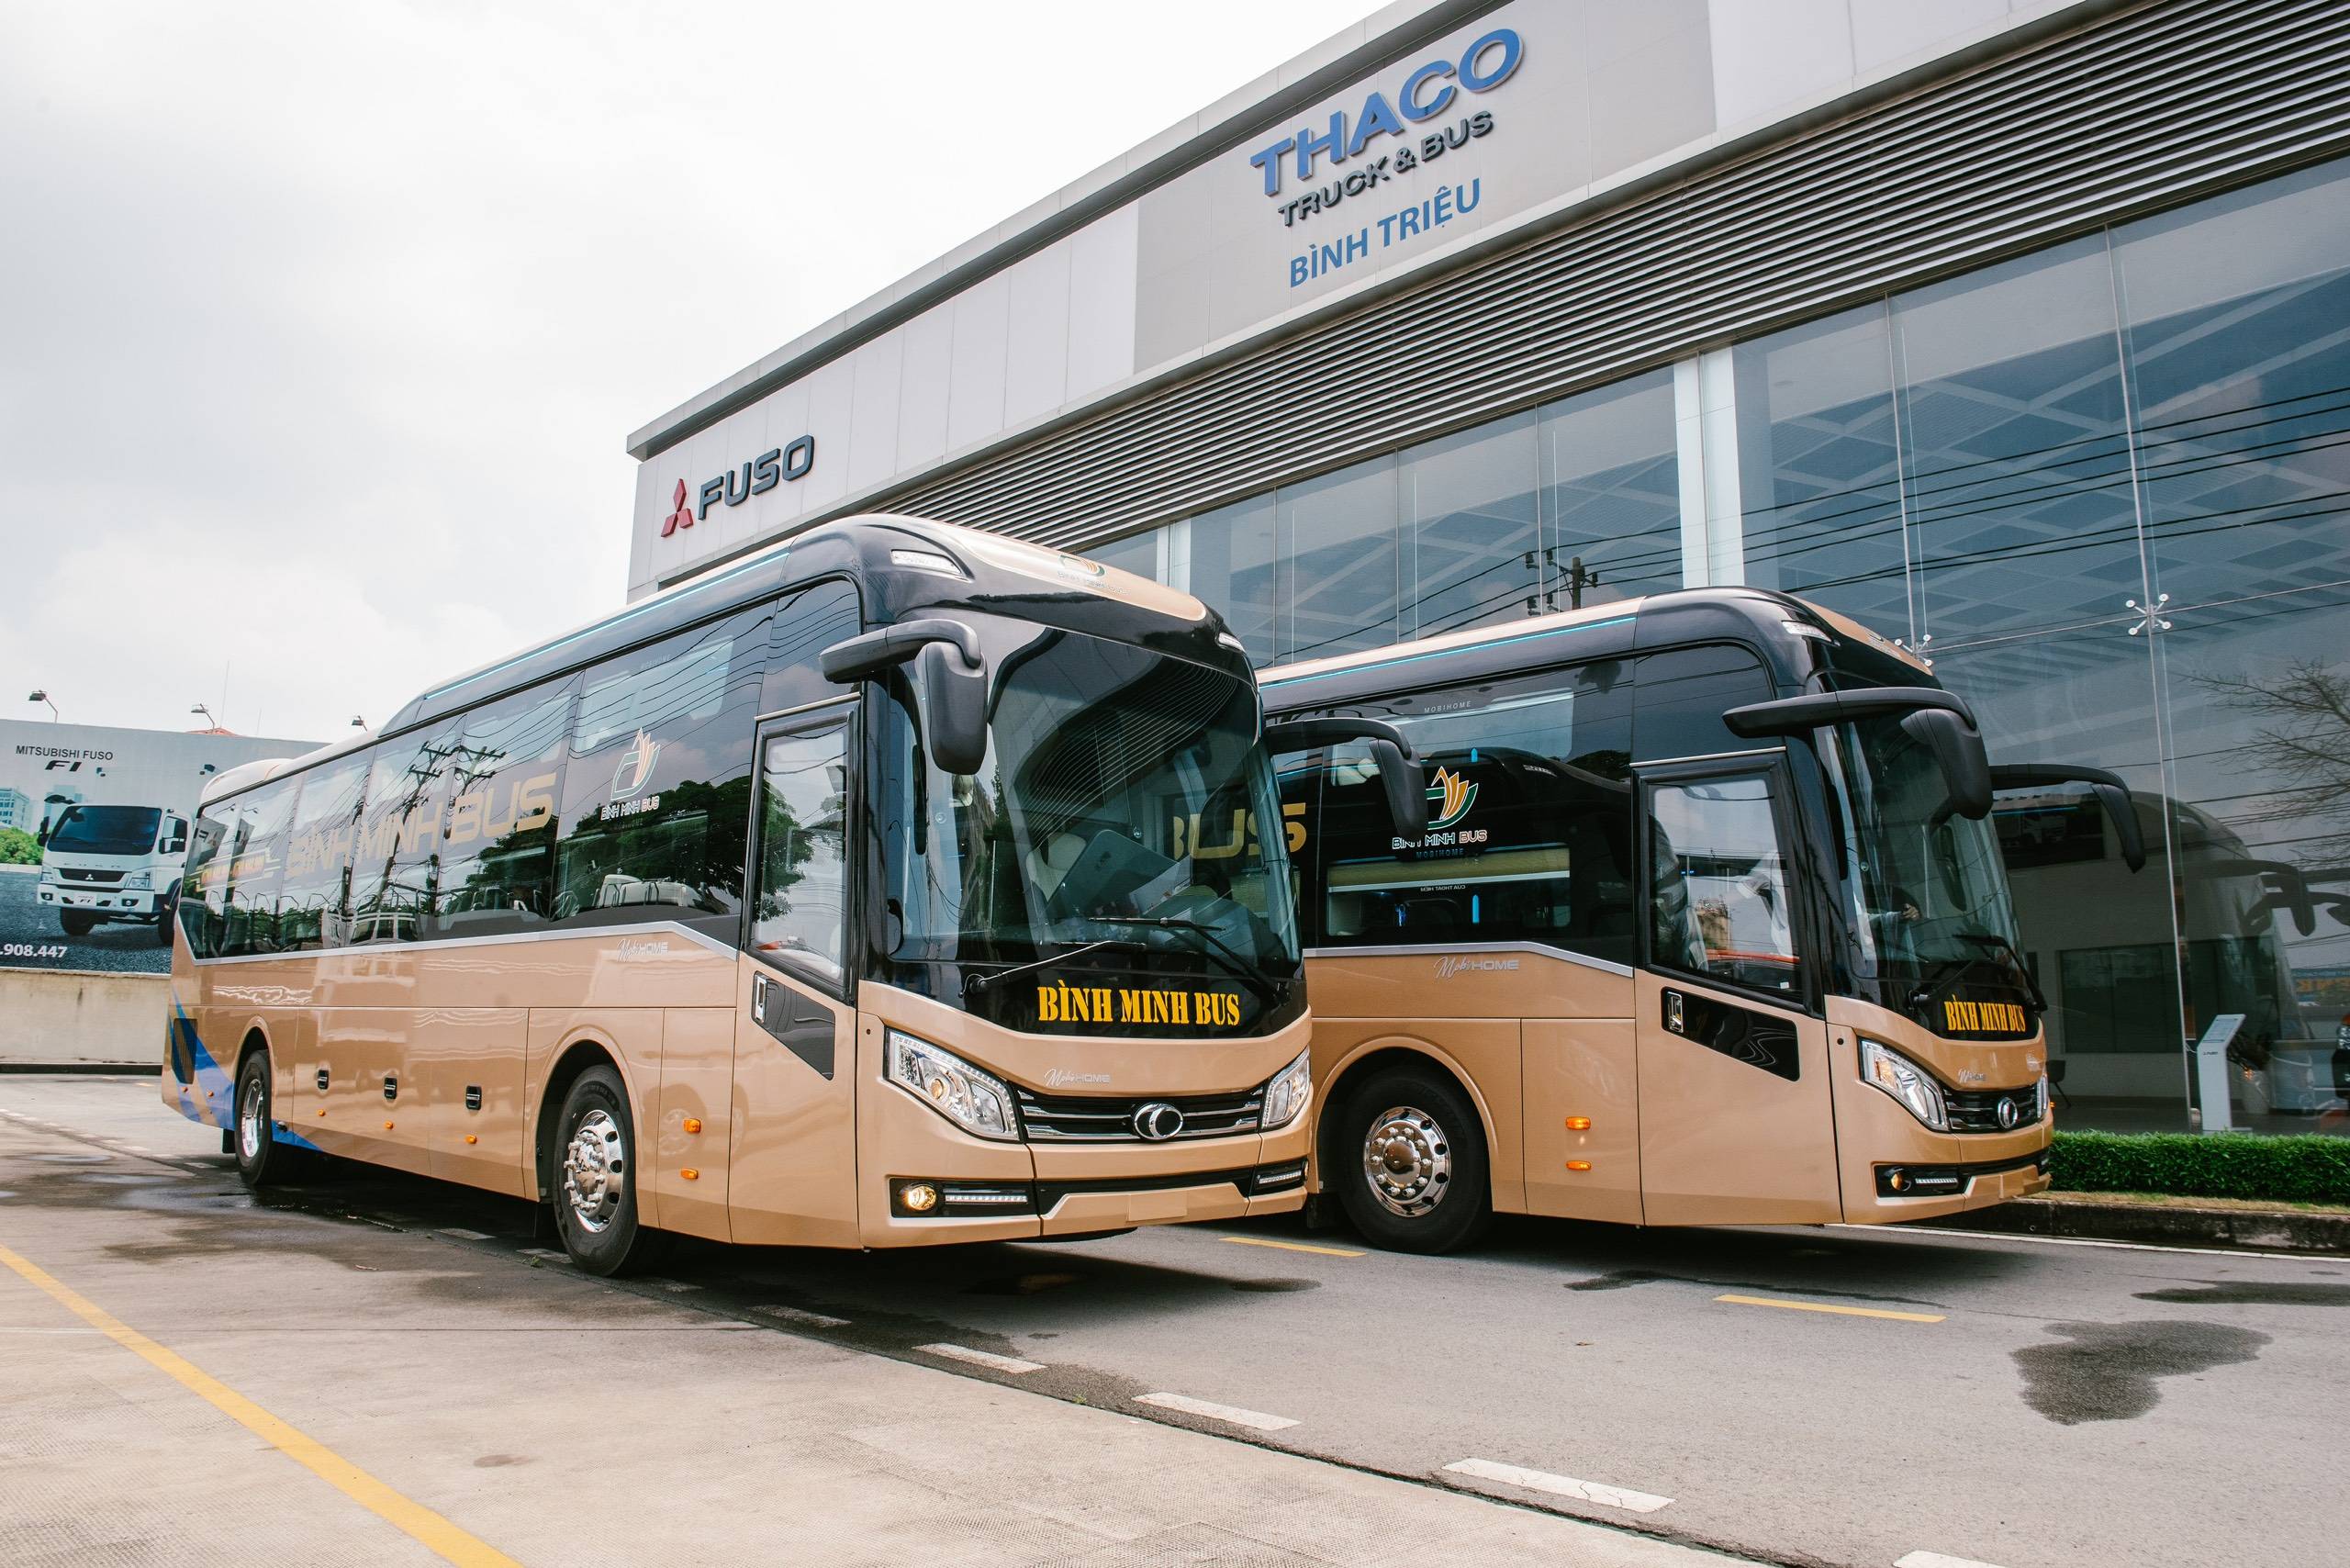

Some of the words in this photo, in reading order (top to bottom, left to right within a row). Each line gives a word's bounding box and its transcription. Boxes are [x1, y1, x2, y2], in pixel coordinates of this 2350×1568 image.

[1249, 28, 1524, 197] THACO
[1277, 155, 1391, 228] TRUCK
[1392, 146, 1416, 174] &
[1419, 109, 1494, 162] BUS
[1290, 227, 1369, 288] BÌNH
[1376, 177, 1481, 248] TRIỆU
[698, 433, 815, 521] FUSO
[16, 745, 81, 759] MITSUBISHI
[83, 750, 114, 761] FUSO
[447, 772, 556, 846] BUS
[641, 795, 660, 812] BUS
[1424, 832, 1456, 847] MINH
[1458, 829, 1488, 845] BUS
[1036, 980, 1113, 1022] BÌNH
[1119, 989, 1189, 1025] MINH
[1193, 991, 1240, 1025] BUS
[1944, 993, 1979, 1031] BÌNH
[1978, 1002, 2009, 1032] MINH
[2007, 1003, 2026, 1033] BUS
